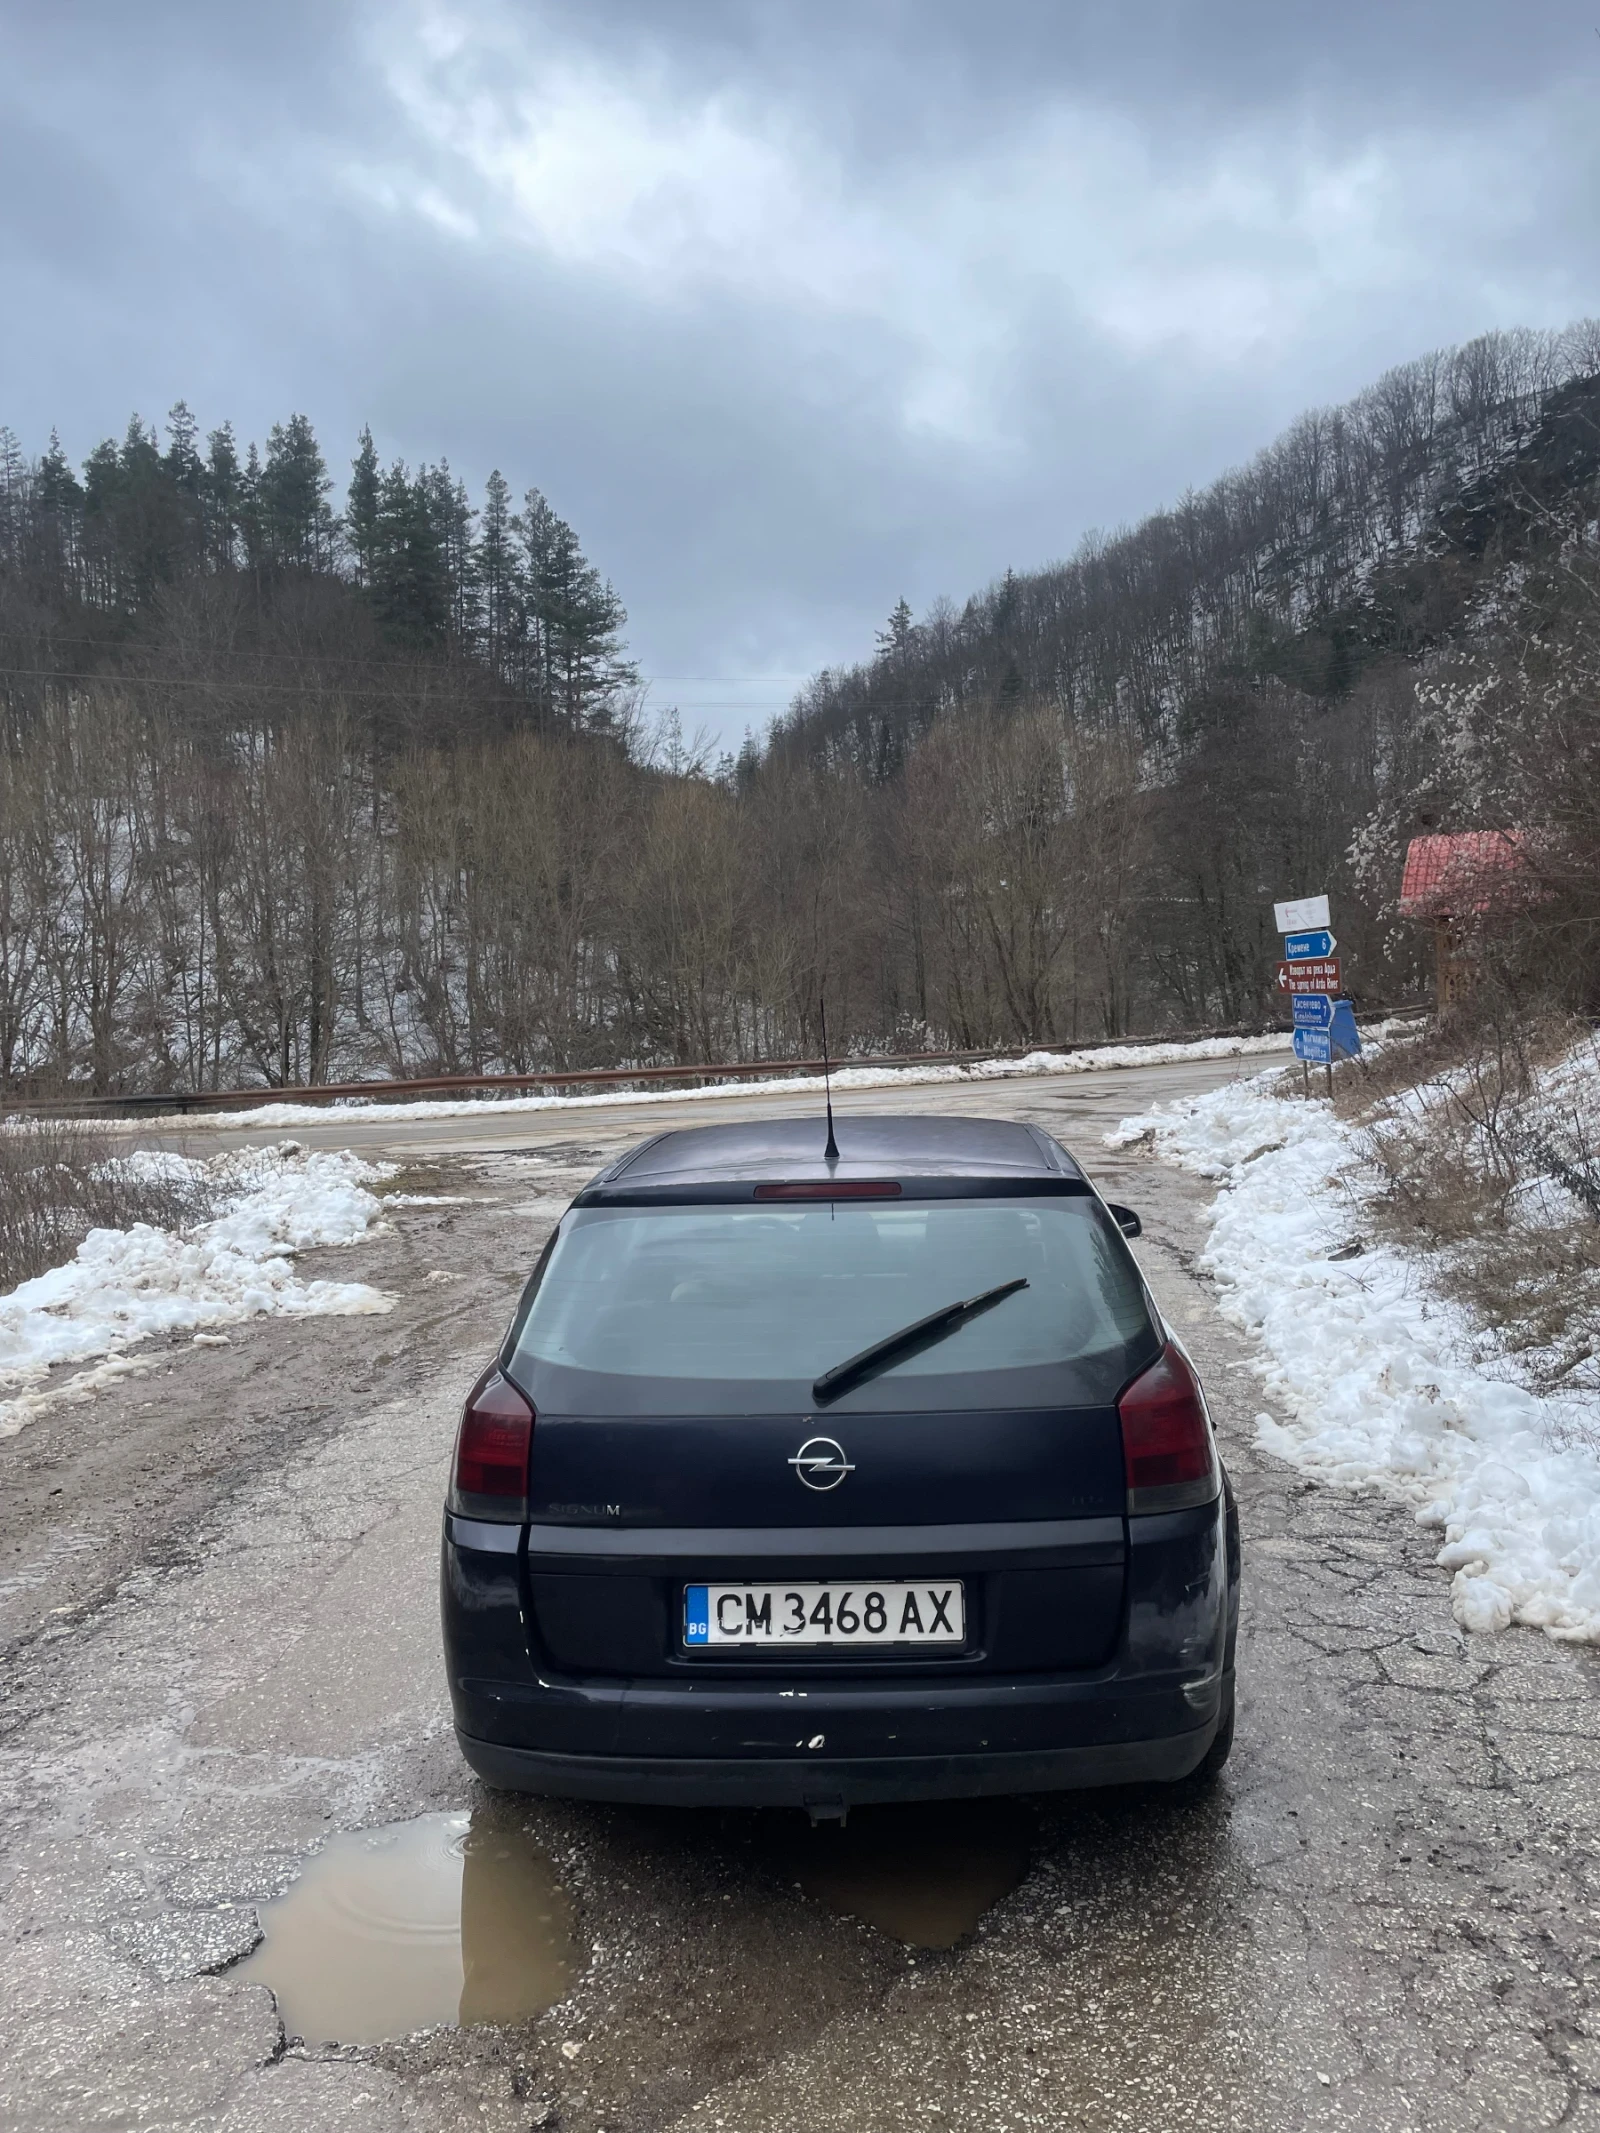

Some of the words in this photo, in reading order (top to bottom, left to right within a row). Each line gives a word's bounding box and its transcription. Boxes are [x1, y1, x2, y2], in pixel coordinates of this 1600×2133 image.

[1288, 942, 1310, 956] Кремене
[1322, 938, 1327, 950] 6
[1306, 966, 1312, 974] на
[1313, 965, 1323, 977] река
[1324, 962, 1336, 976] Арда
[1296, 980, 1309, 993] spring
[1310, 978, 1315, 989] of
[1316, 978, 1325, 989] Arda
[1327, 978, 1338, 989] River
[1323, 1005, 1327, 1017] 7
[1296, 1038, 1300, 1049] 2
[548, 1503, 620, 1516] SIGNUM
[782, 1591, 888, 1636] 3468
[898, 1590, 955, 1634] AX
[688, 1622, 707, 1636] BG
